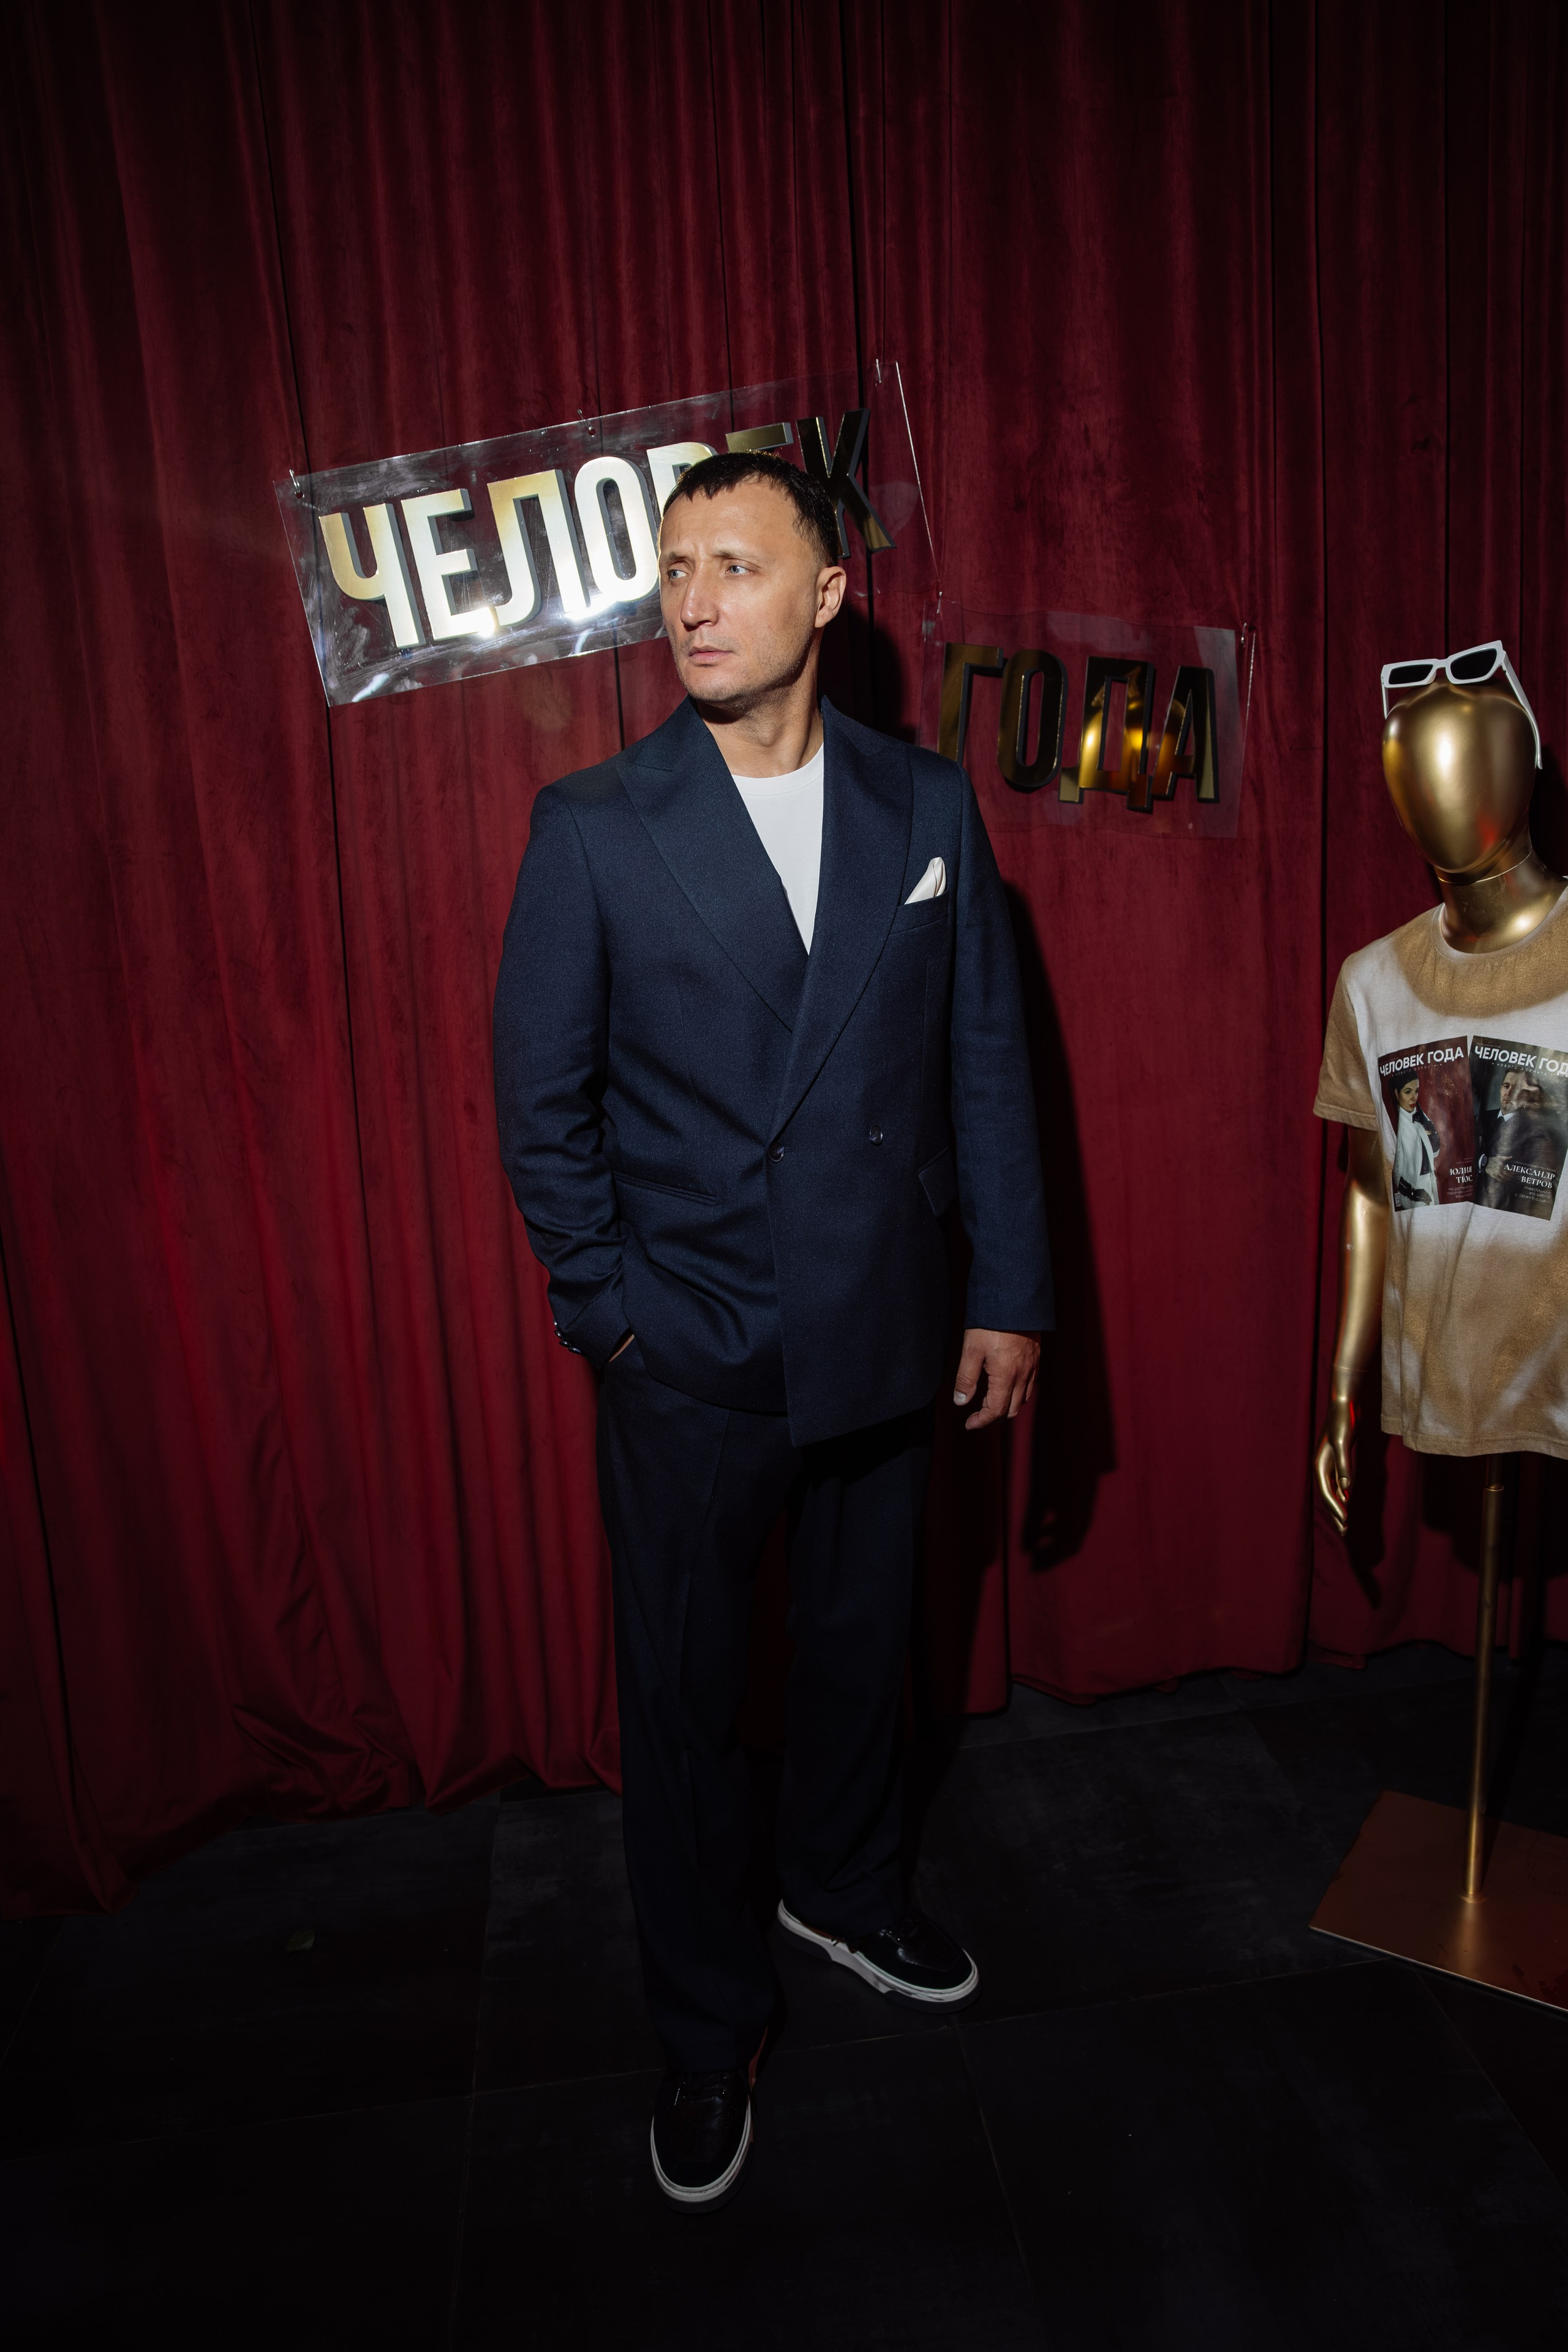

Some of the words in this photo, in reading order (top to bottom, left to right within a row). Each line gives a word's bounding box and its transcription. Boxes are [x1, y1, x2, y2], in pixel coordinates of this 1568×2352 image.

[318, 409, 896, 649] ЧЕЛОК
[938, 642, 1219, 813] ГОДА
[1379, 1053, 1425, 1077] ЧЕЛОВЕК
[1427, 1046, 1464, 1064] ГОДА
[1474, 1046, 1537, 1068] ЧЕЛОВЕК
[1450, 1166, 1472, 1175] ЮЛИЯ
[1455, 1175, 1473, 1183] ТЮС
[1504, 1164, 1555, 1180] АЛЕКСАНДР
[1521, 1175, 1553, 1188] ВЕТРОВ
